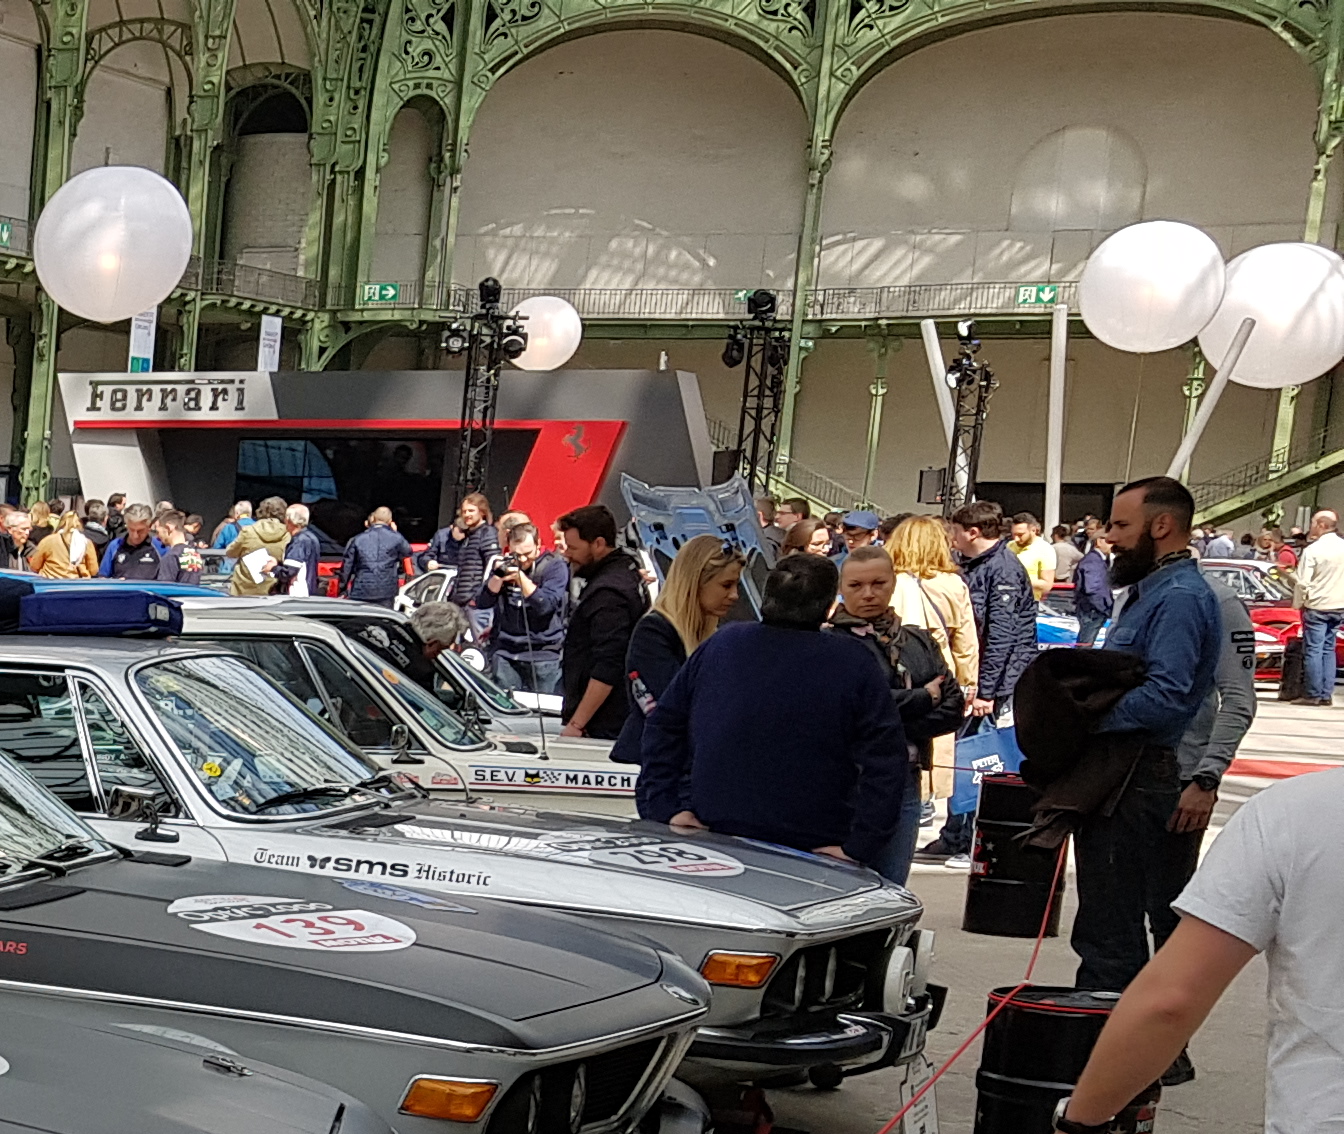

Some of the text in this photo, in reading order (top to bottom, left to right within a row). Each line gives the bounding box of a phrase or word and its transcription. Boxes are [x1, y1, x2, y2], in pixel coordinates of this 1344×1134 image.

[86, 379, 246, 412] Ferrari
[253, 847, 492, 887] Team sms Historic
[177, 904, 264, 922] Optic
[252, 915, 366, 940] 139
